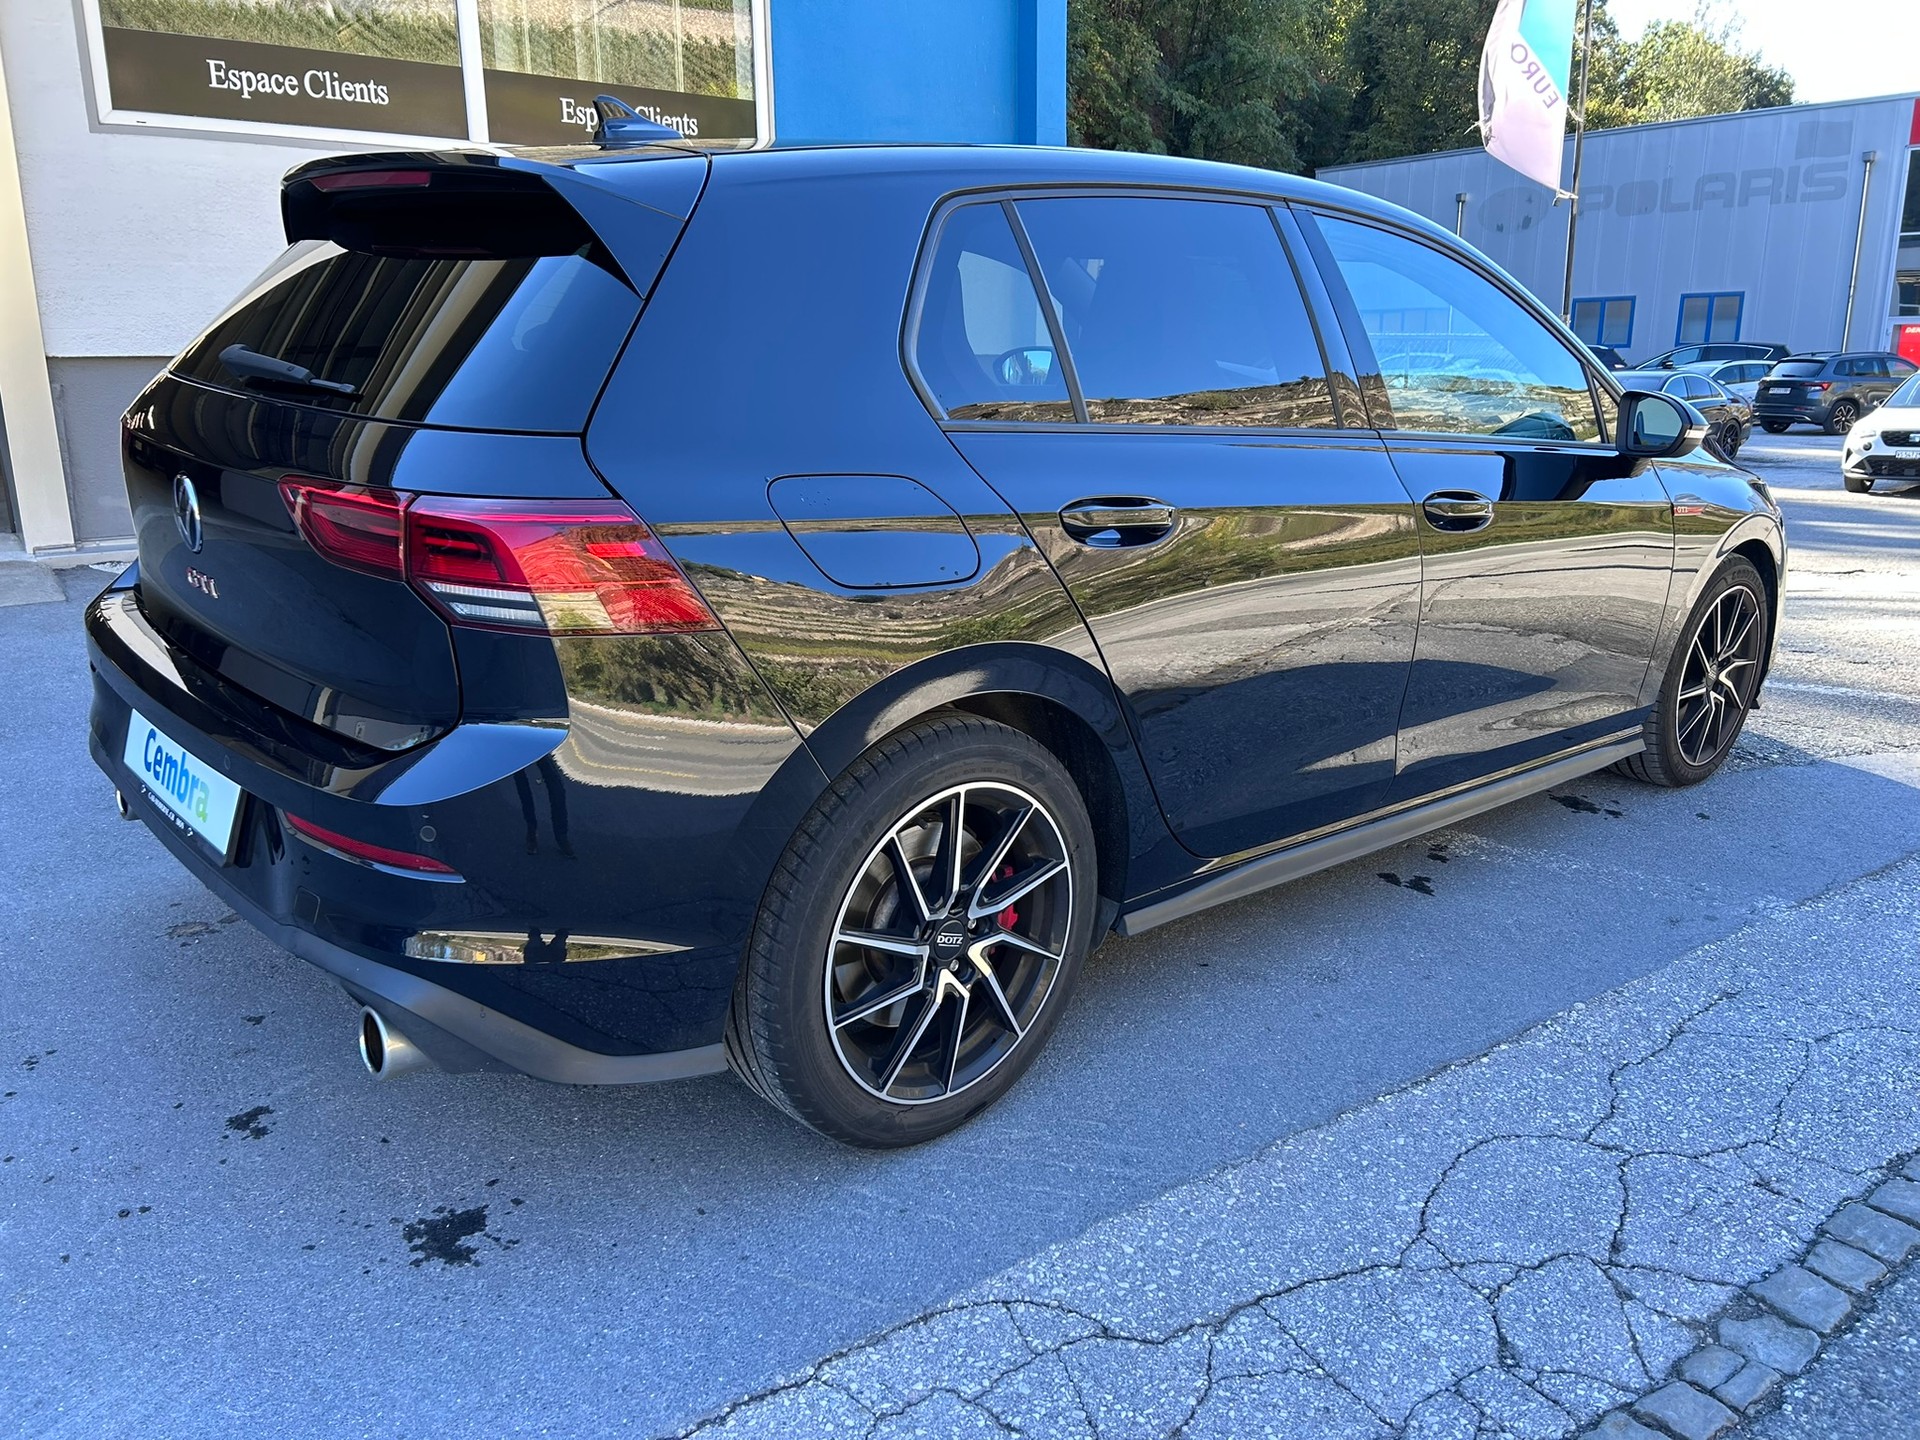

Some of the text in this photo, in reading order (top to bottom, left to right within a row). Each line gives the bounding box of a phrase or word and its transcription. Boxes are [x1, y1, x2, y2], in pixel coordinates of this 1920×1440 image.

[205, 58, 390, 105] Espace Clients
[1577, 161, 1849, 219] POLARIS
[186, 567, 219, 599] GTI
[144, 728, 210, 823] Cembra
[936, 935, 964, 945] DOTZ
